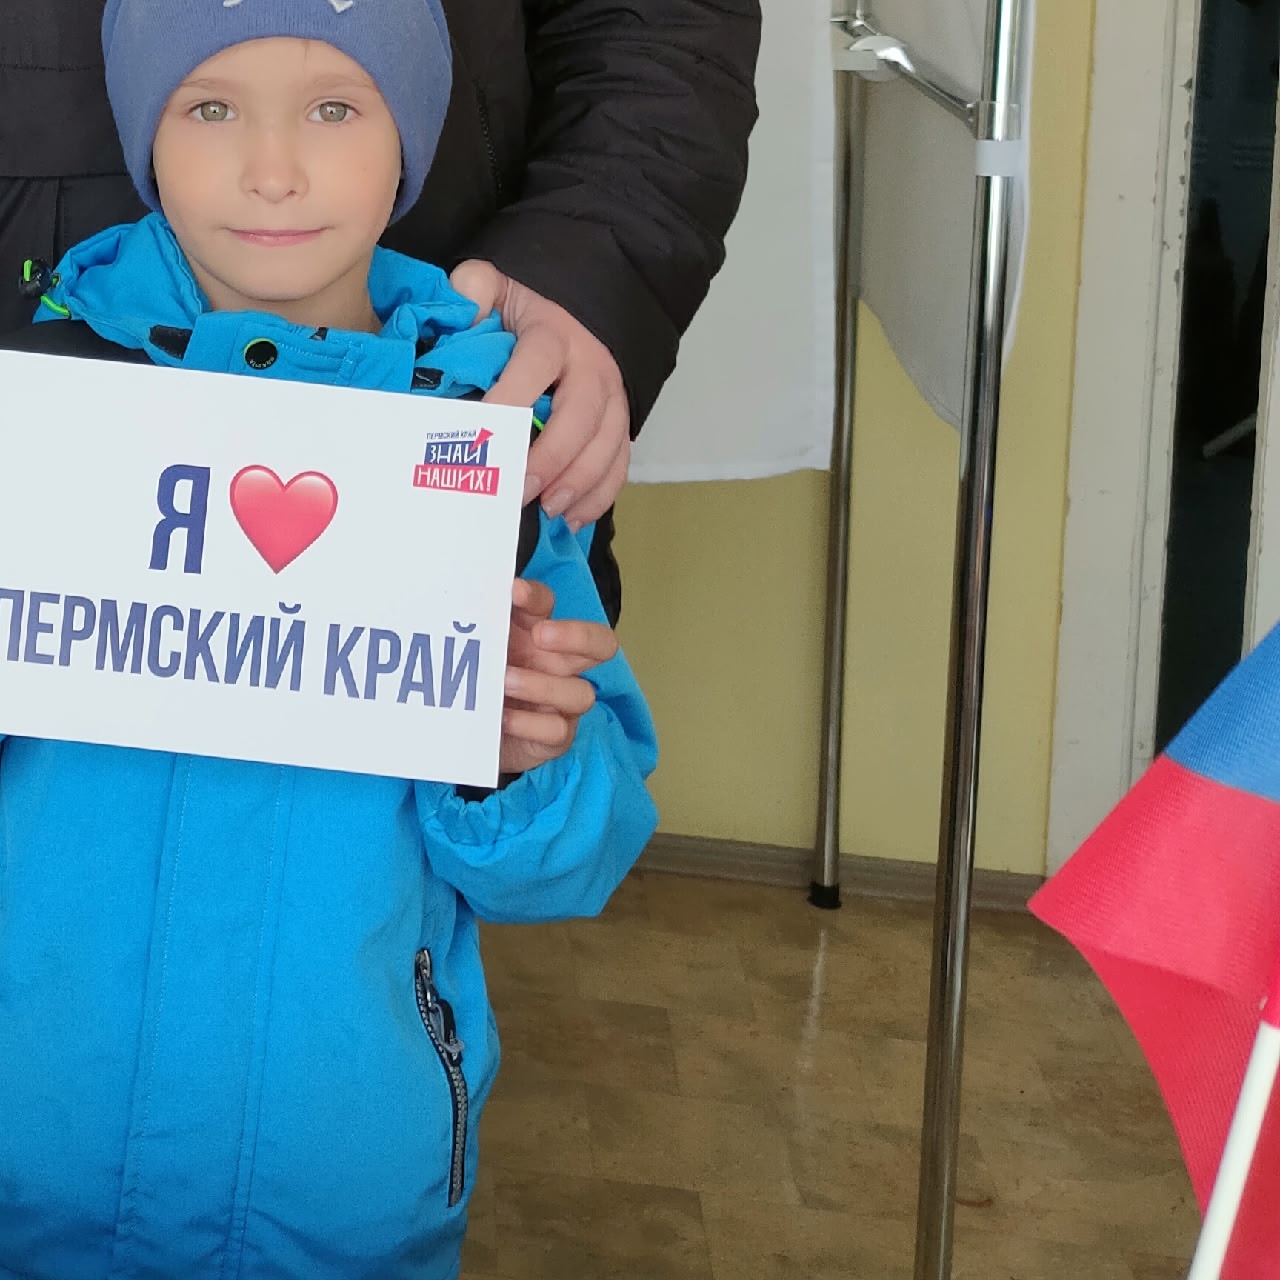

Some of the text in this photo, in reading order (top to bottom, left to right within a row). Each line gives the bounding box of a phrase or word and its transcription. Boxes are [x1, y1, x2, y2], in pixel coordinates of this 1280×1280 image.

[426, 429, 476, 440] ПЕРМСКИЙ КРАЙ
[429, 438, 483, 464] ЗНАЙ
[417, 466, 493, 493] НАШИХ!
[148, 463, 211, 575] Я
[323, 620, 481, 712] КРАЙ
